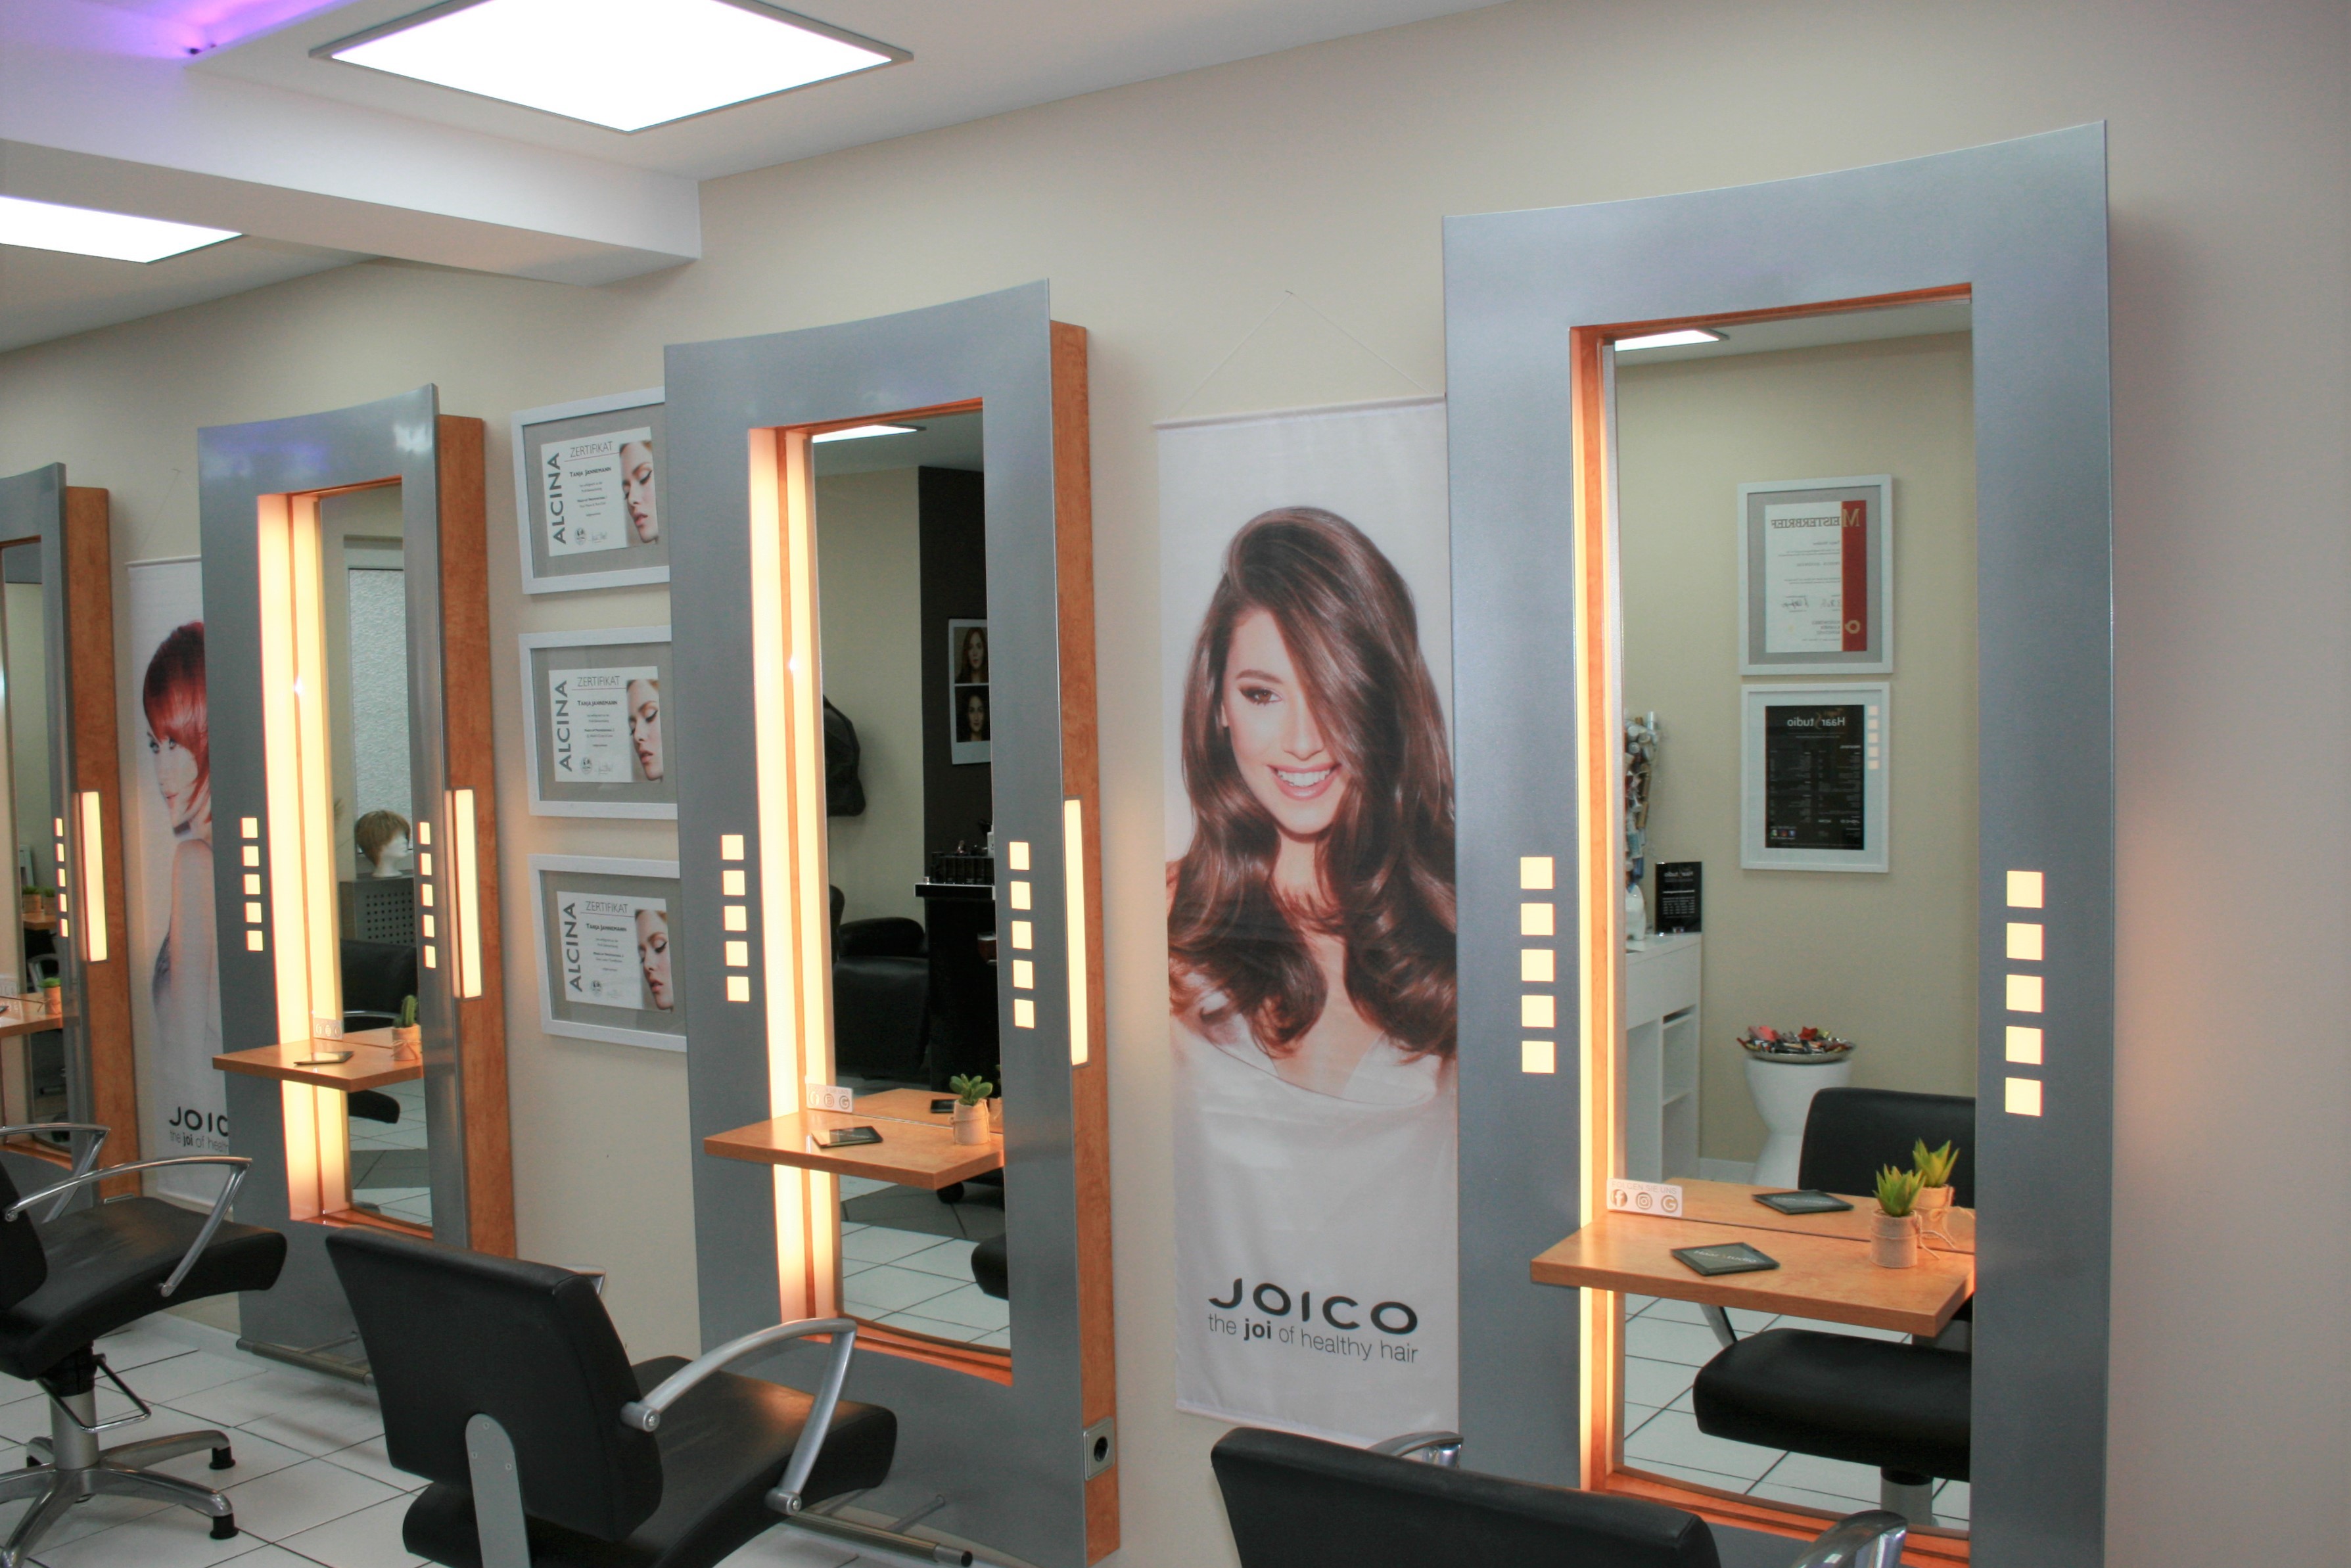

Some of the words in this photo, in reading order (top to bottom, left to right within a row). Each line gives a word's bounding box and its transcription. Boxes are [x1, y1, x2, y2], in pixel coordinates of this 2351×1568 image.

[570, 441, 613, 457] ZERTIFIKAT
[547, 452, 567, 545] ALCINA
[577, 676, 620, 687] ZERTIFIKAT
[555, 680, 572, 772] ALCINA
[585, 900, 628, 913] ZERTIFIKAT
[563, 902, 583, 992] ALCINA
[169, 1106, 228, 1137] JOIC
[183, 1132, 193, 1147] joi
[195, 1135, 204, 1149] of
[1612, 1181, 1643, 1190] FOLGEN
[1208, 1278, 1418, 1335] JOICO
[1207, 1313, 1237, 1335] the
[1244, 1318, 1271, 1341] joi
[1278, 1326, 1295, 1344] of
[1301, 1328, 1372, 1362] healthy
[1380, 1339, 1419, 1364] hair
